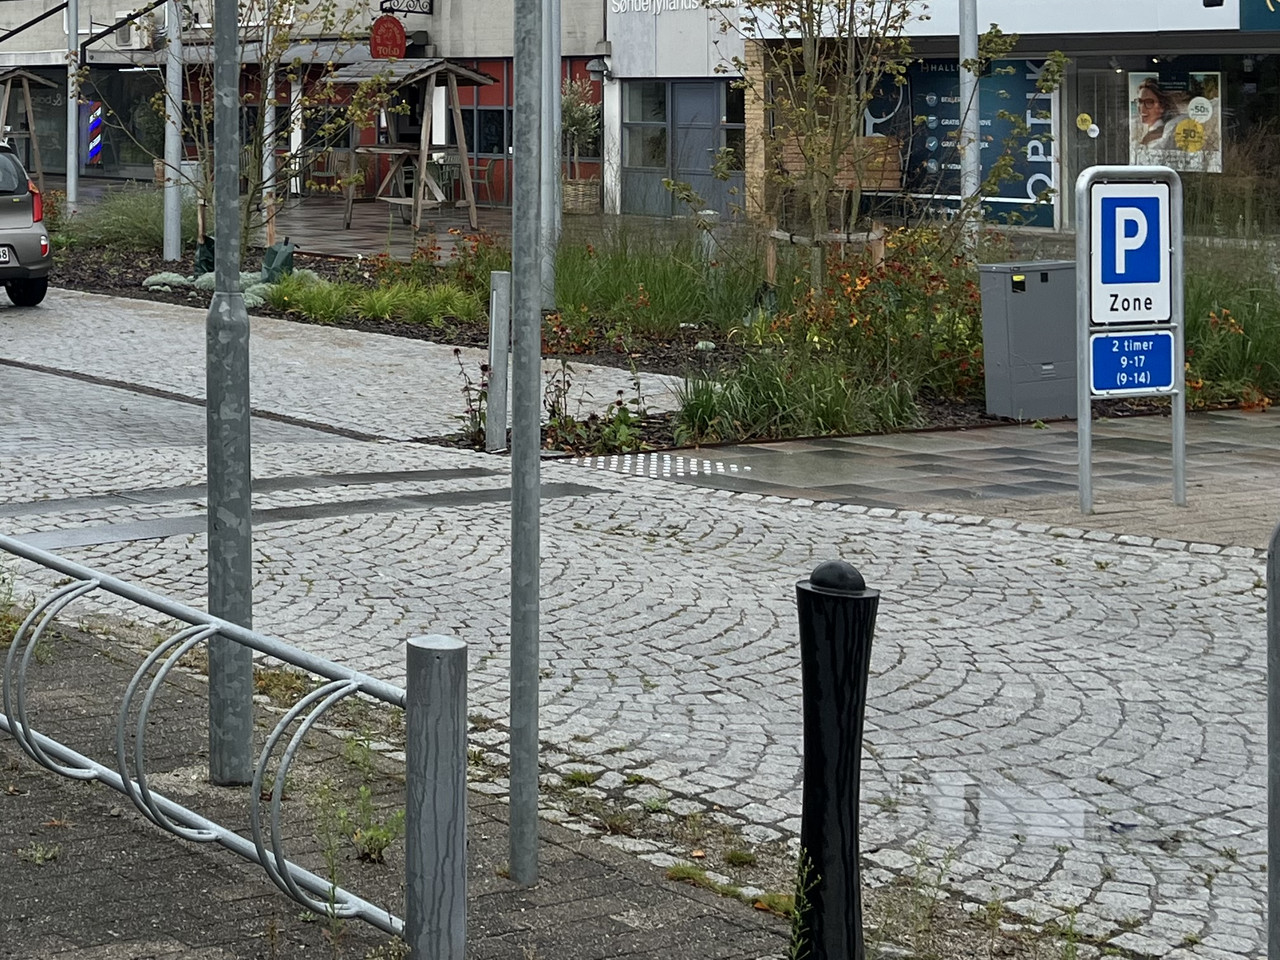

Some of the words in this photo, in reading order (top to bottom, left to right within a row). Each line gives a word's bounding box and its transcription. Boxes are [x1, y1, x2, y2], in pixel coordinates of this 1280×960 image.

[1115, 207, 1148, 274] P
[1110, 294, 1153, 312] Zone
[1112, 341, 1119, 352] 2
[1123, 339, 1153, 351] timer
[1121, 356, 1145, 368] 9-17
[1117, 371, 1151, 385] (9-14)
